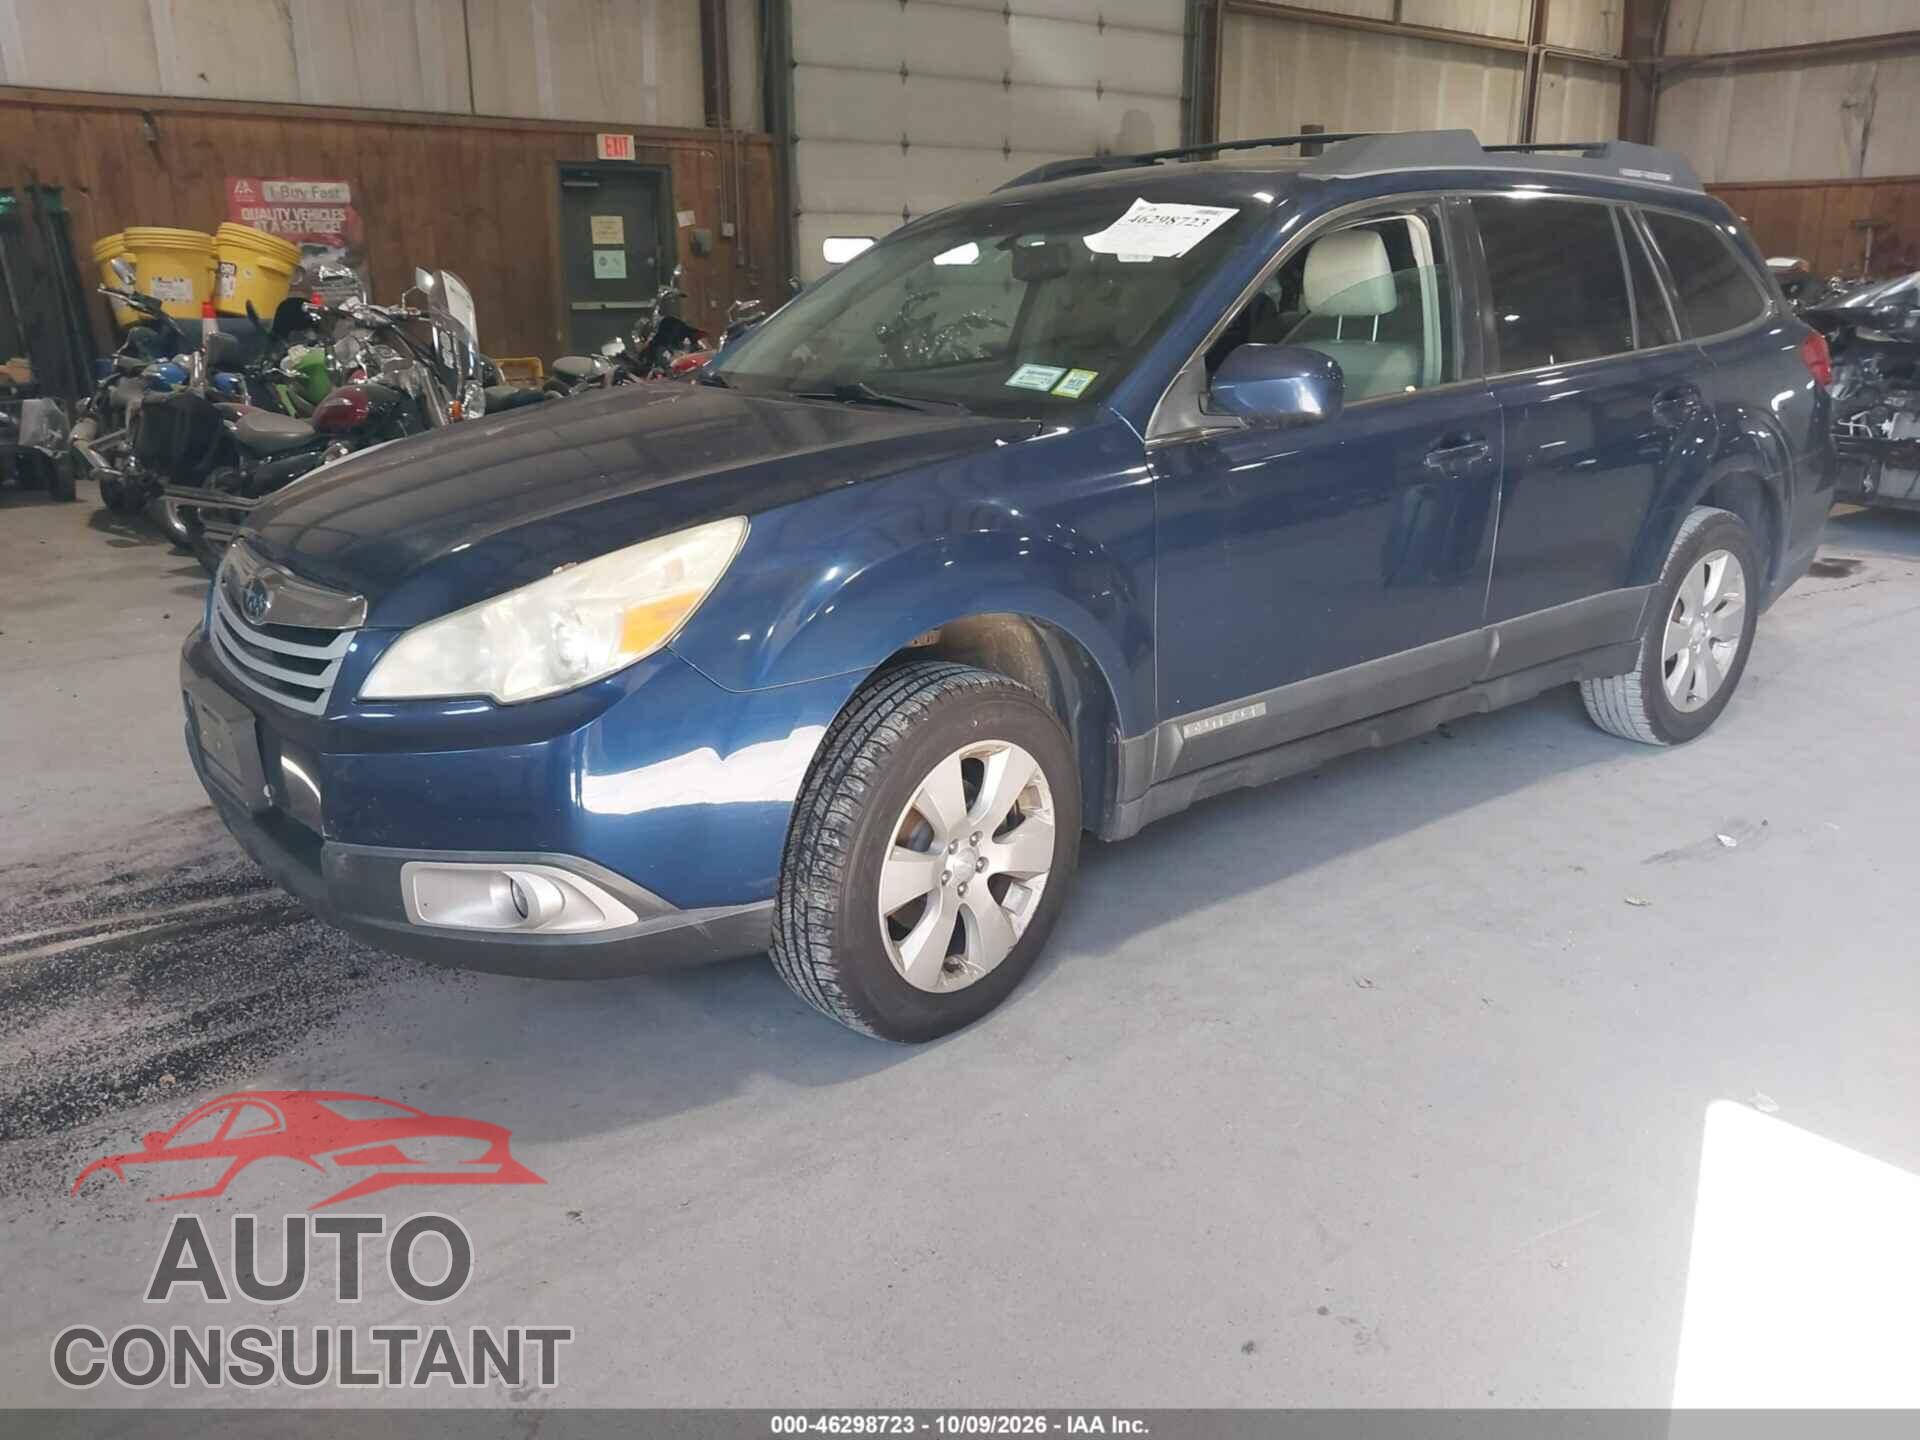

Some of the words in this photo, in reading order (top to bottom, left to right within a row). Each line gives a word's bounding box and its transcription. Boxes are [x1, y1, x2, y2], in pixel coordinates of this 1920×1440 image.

[604, 136, 629, 157] EXIT
[311, 185, 342, 199] Fast
[240, 207, 290, 221] QUALITY
[292, 208, 346, 221] VEHICLES
[1128, 215, 1211, 227] 46298723
[281, 221, 303, 233] SET
